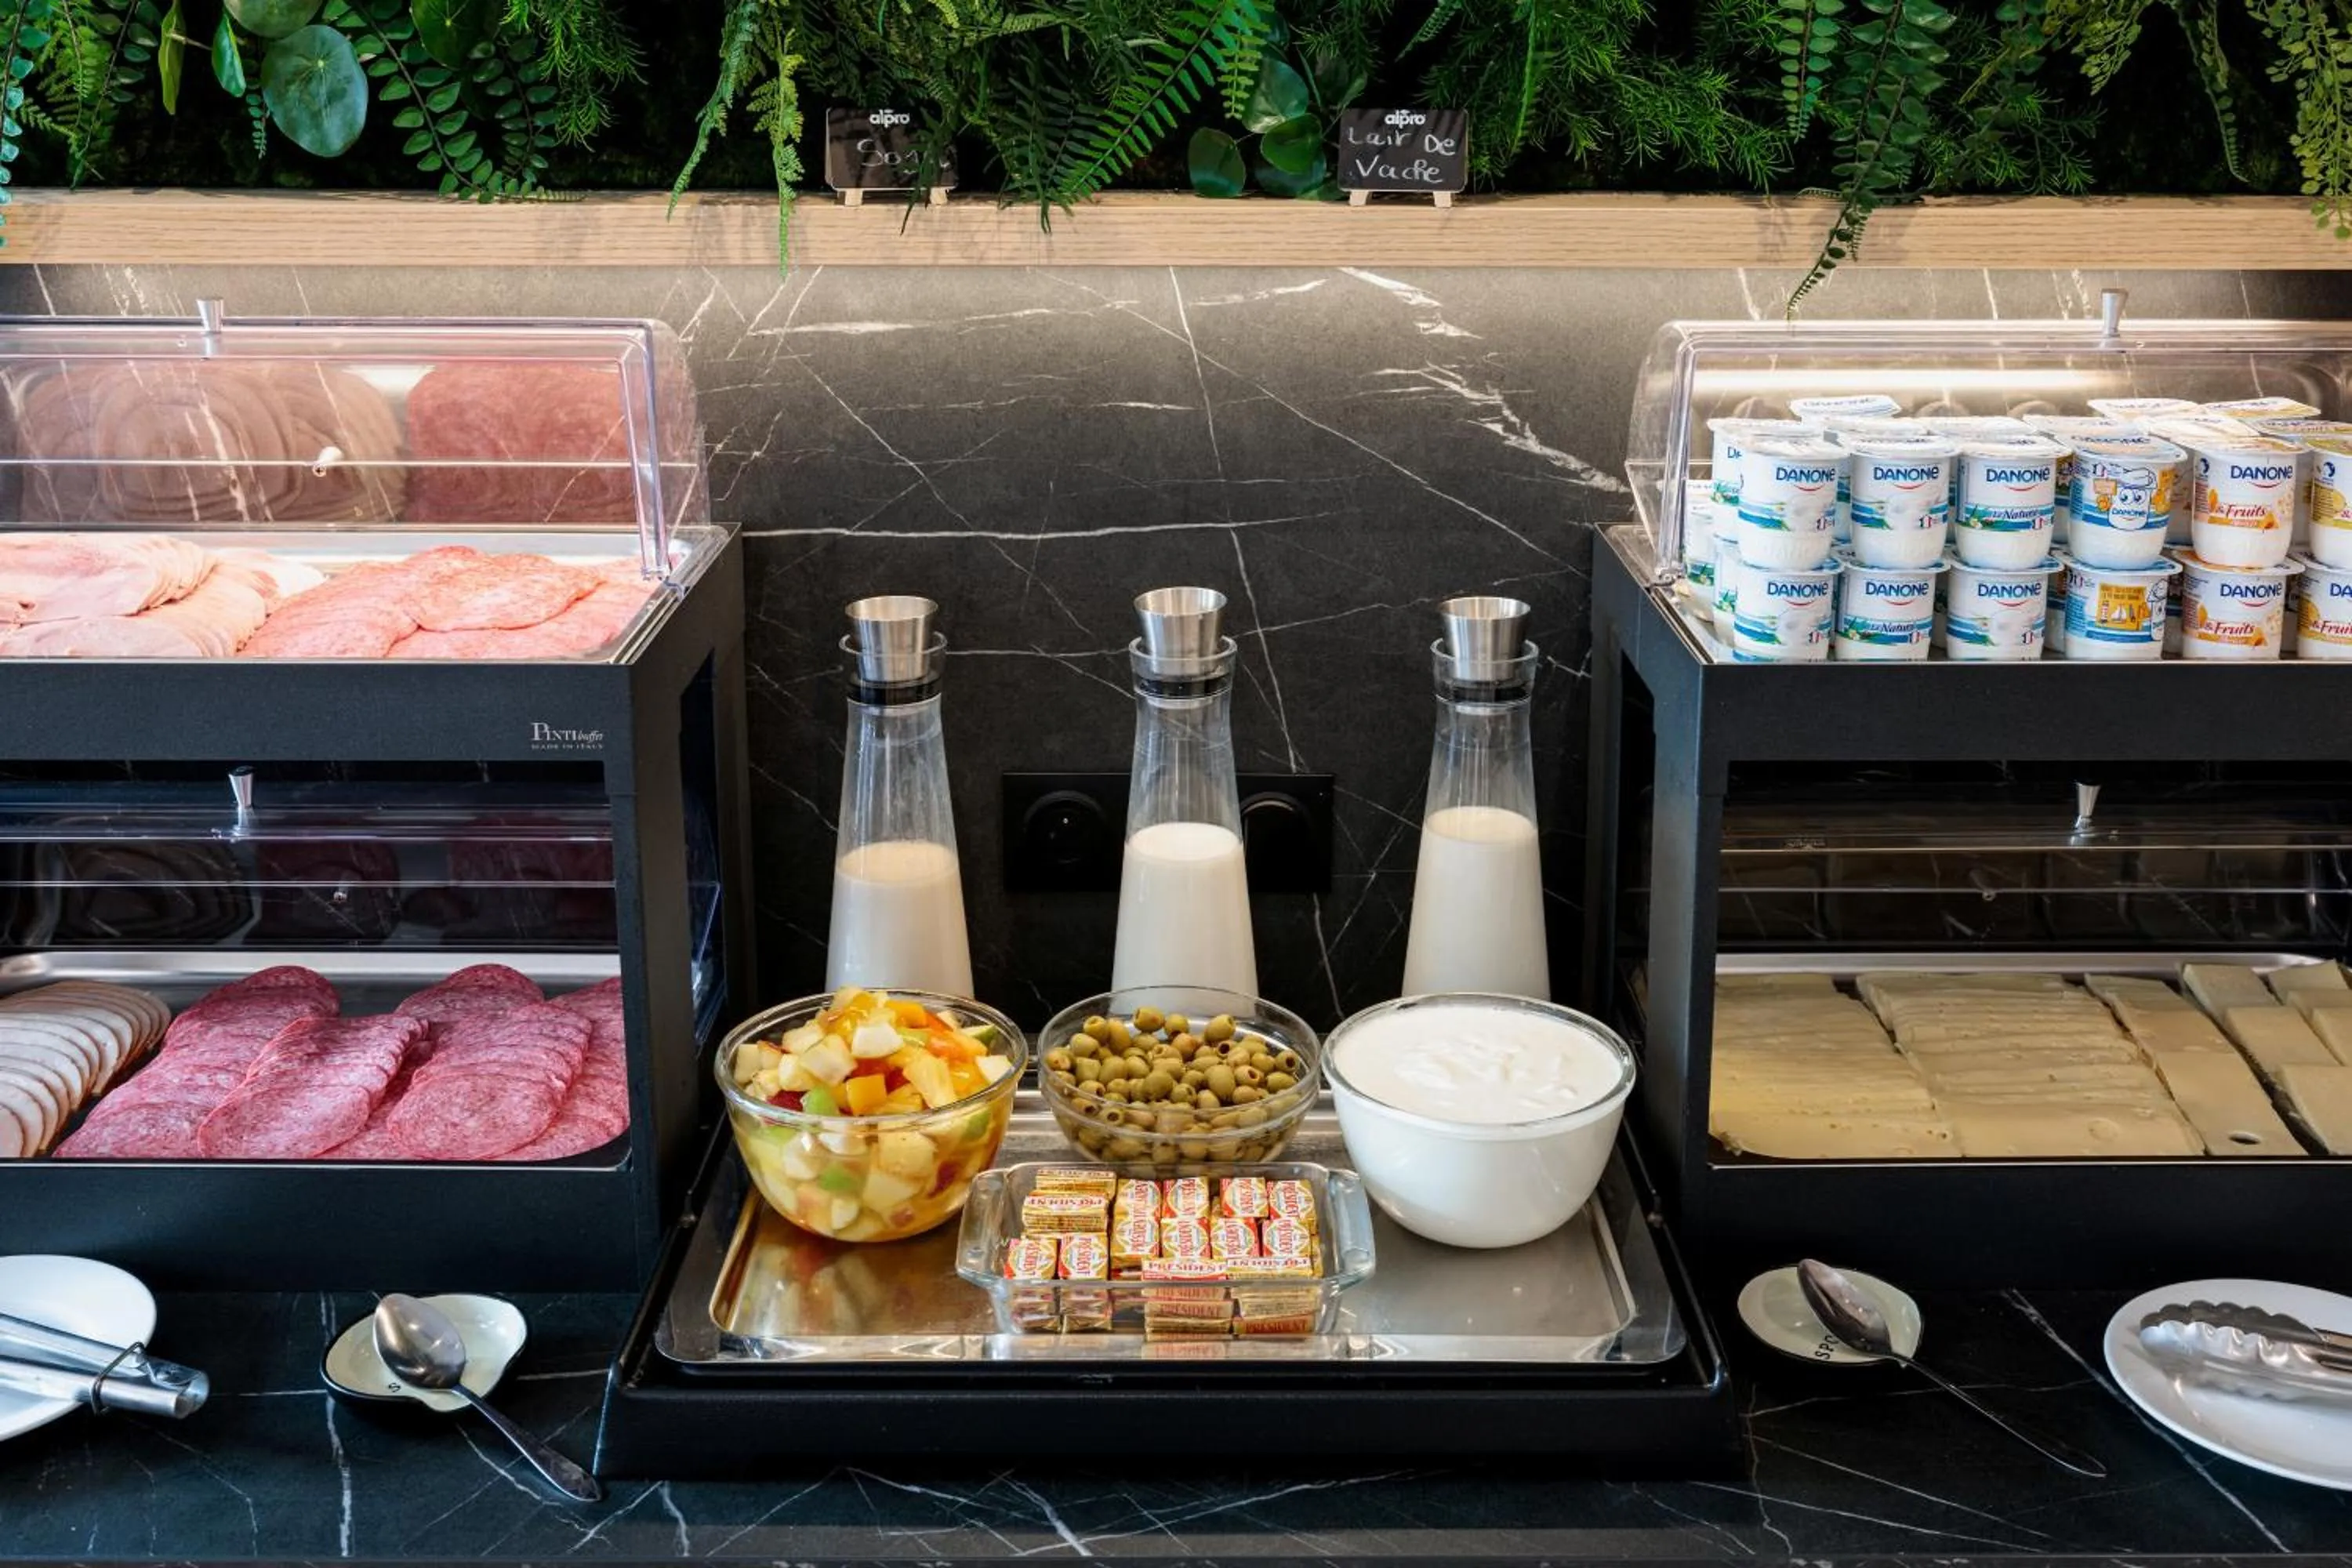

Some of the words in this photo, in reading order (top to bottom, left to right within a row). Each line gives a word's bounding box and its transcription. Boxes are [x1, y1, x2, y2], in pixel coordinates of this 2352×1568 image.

[869, 110, 910, 128] alpro
[1385, 110, 1426, 129] alpro
[1355, 154, 1443, 183] Vache
[1874, 466, 1940, 481] DANONE
[1986, 467, 2050, 482] DANONE
[2230, 465, 2293, 480] DANONE
[2225, 504, 2267, 517] Fruits
[1768, 582, 1828, 597] DANONE
[1866, 582, 1929, 597] DANONE
[1978, 583, 2042, 597] DANONE
[2220, 582, 2282, 597] DANONE
[2214, 622, 2255, 633] Fruits
